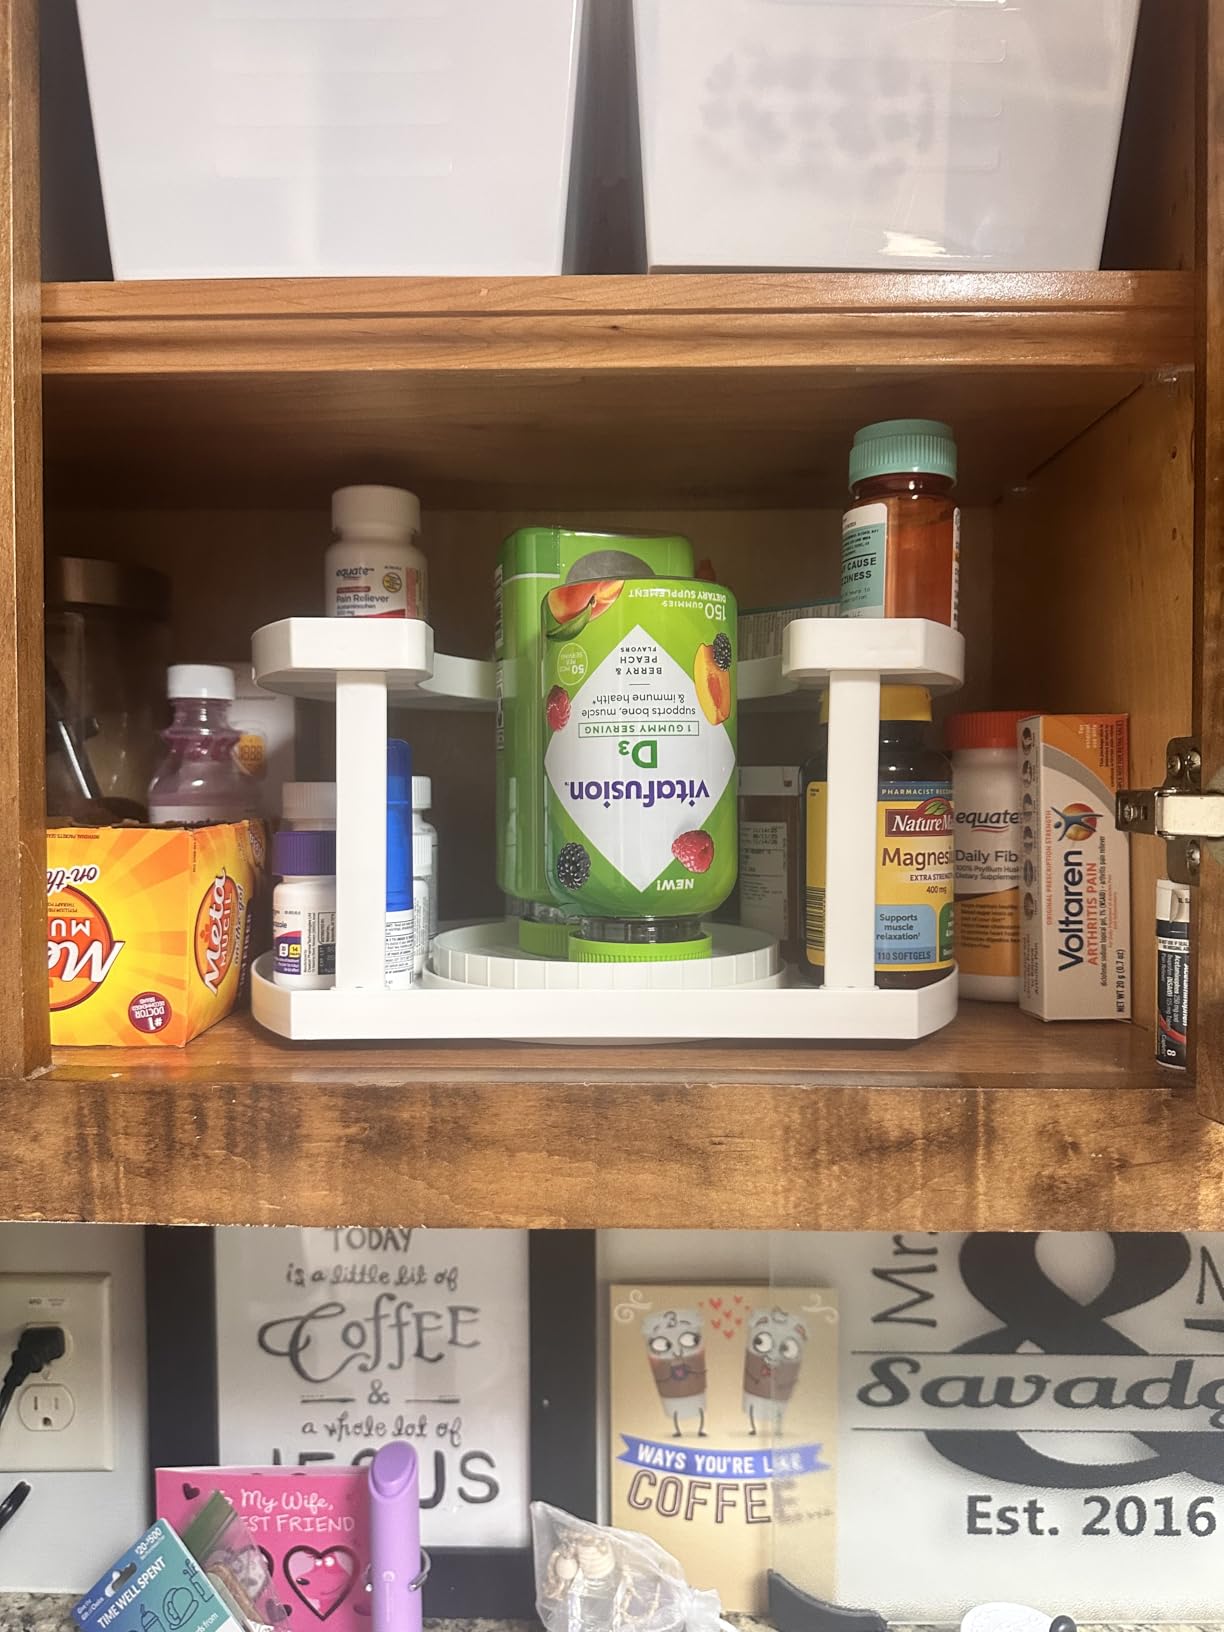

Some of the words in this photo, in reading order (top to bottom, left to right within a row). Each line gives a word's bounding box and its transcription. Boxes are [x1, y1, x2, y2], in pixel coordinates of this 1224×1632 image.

[847, 557, 876, 570] CAUSE
[336, 567, 368, 576] equate
[629, 588, 696, 599] SUPPLEMENT
[697, 590, 726, 602] DIETARY
[662, 600, 703, 608] GUMMIES
[705, 604, 726, 621] 150
[619, 655, 658, 664] PEACH
[571, 664, 585, 674] 50
[615, 667, 622, 675] &
[625, 667, 662, 675] BERRY
[631, 694, 676, 704] immune
[678, 694, 685, 703] &
[581, 708, 616, 720] muscle
[618, 707, 649, 718] bone,
[651, 705, 696, 718] supports
[584, 725, 635, 735] SERVING
[639, 724, 684, 734] GUMMY
[688, 725, 692, 733] 1
[618, 740, 658, 769] D3
[569, 779, 710, 808] vitafusion
[956, 810, 1019, 827] equate
[882, 848, 951, 870] Magnes
[956, 850, 990, 864] Daily
[995, 851, 1018, 862] Fib
[47, 866, 98, 891] on-th
[1086, 862, 1097, 893] PAIN
[655, 878, 695, 891] NEW!
[1058, 850, 1084, 971] Voltaren
[880, 914, 918, 922] Supports
[204, 868, 226, 994] Meta
[221, 892, 232, 966] MUCIL
[1086, 897, 1098, 966] ARTHRITIS
[893, 951, 931, 960] SOFTGELS
[1116, 949, 1124, 960] oz)
[47, 940, 125, 983] Me
[1116, 961, 1124, 973] (0.7
[1116, 989, 1124, 1000] WT
[135, 1006, 165, 1018] DOCTOR
[1116, 1001, 1124, 1012] NET
[148, 1017, 162, 1030] #1
[330, 1228, 414, 1252] TODAY
[286, 1263, 306, 1287] is
[312, 1272, 326, 1282] a
[331, 1264, 390, 1285] little
[394, 1264, 428, 1286] bit
[435, 1266, 458, 1291] of
[368, 1380, 390, 1405] &
[856, 1356, 1224, 1429] Savad
[302, 1420, 316, 1434] a
[324, 1411, 387, 1442] whole
[392, 1416, 428, 1438] lot
[436, 1417, 462, 1448] of
[638, 1444, 686, 1470] WAYS
[695, 1455, 754, 1474] YOU'RE
[763, 1453, 802, 1473] LKE
[241, 1489, 277, 1513] My
[281, 1492, 334, 1514] Wife,
[966, 1495, 1059, 1536] Est.
[1082, 1496, 1217, 1537] 2016
[240, 1516, 271, 1532] EST
[276, 1514, 355, 1533] FRIEND
[97, 1607, 119, 1629] TIME
[115, 1587, 141, 1611] WELL
[137, 1556, 166, 1589] SPENT
[203, 1612, 219, 1628] from
